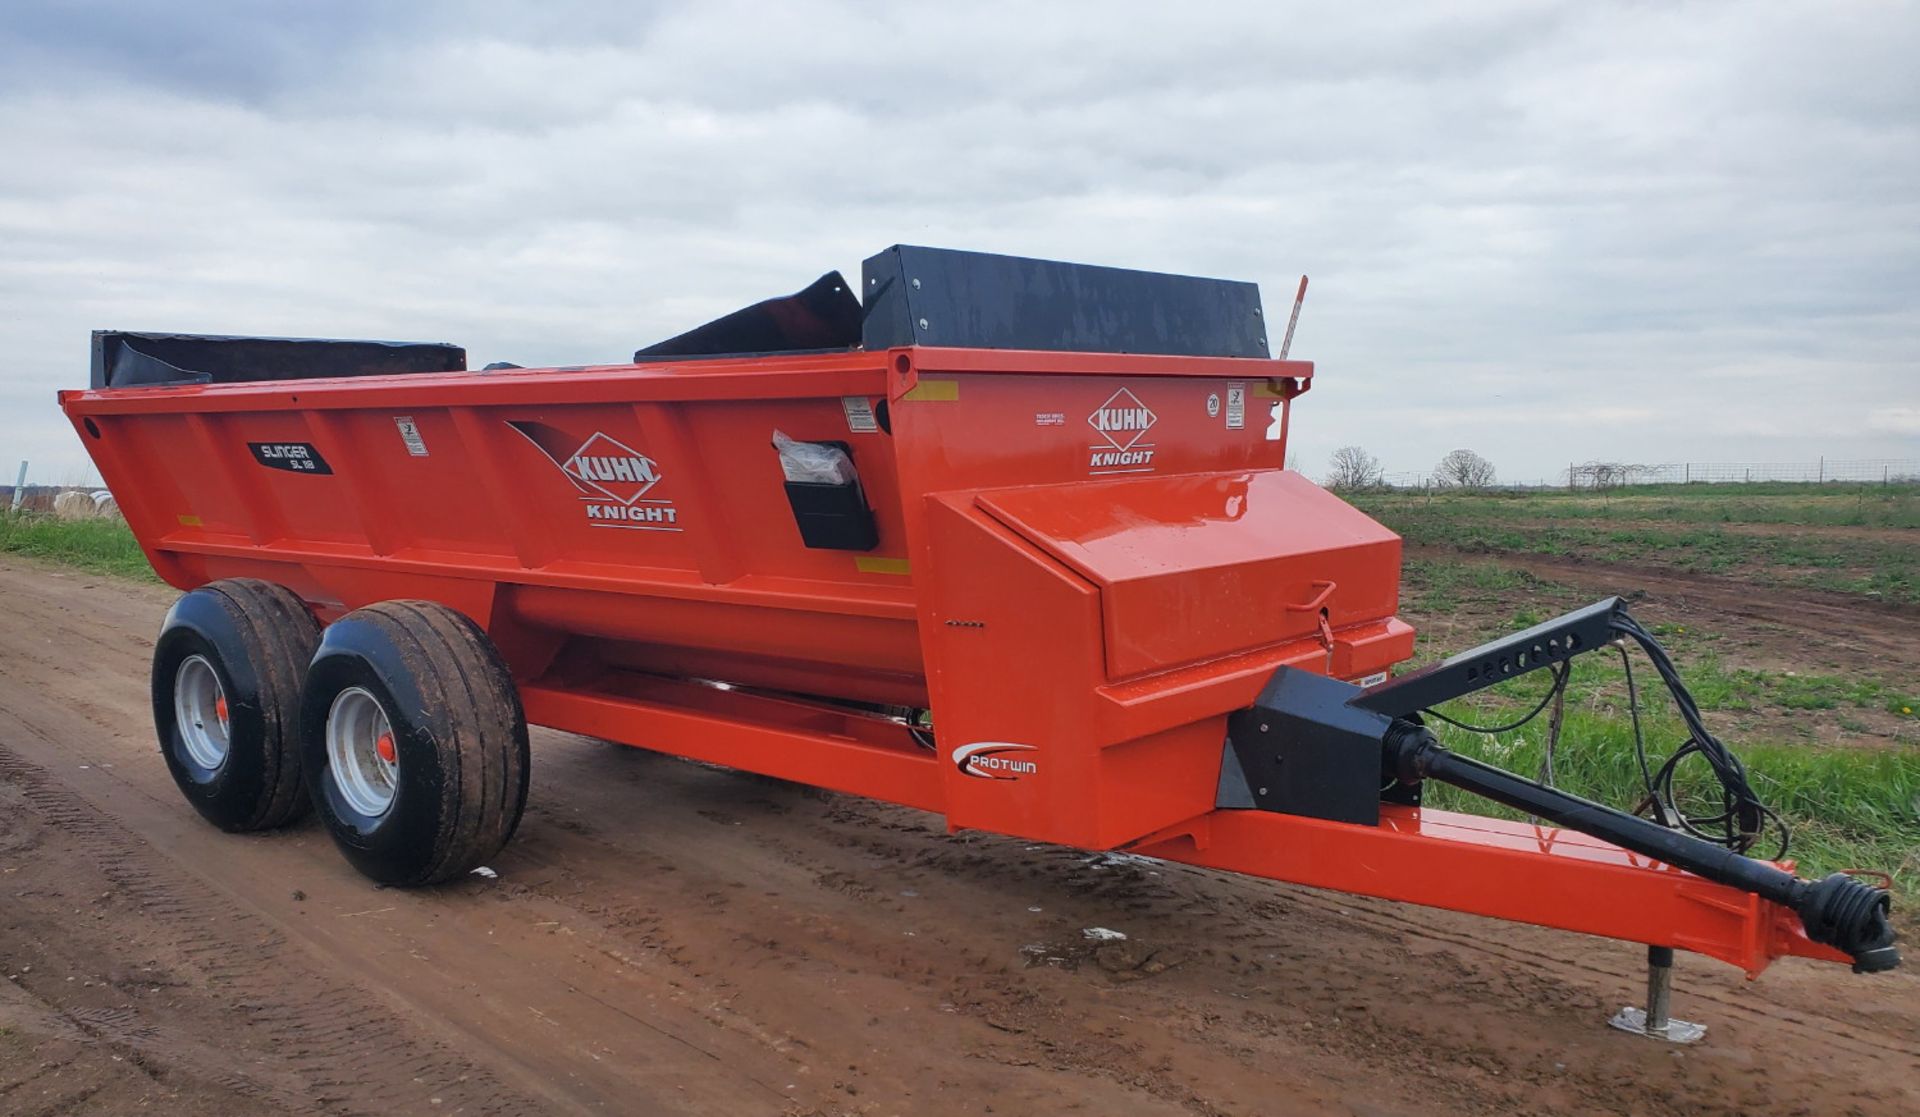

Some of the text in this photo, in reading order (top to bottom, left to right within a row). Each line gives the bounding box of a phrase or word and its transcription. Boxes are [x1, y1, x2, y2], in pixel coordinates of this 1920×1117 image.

[1099, 408, 1148, 431] KUHN
[261, 445, 310, 458] SLINGER
[1090, 451, 1154, 467] KNIGHT
[290, 460, 303, 469] SL
[574, 456, 655, 482] KUHN
[586, 505, 676, 522] KNIGHT
[970, 755, 1037, 774] PROTWIN
